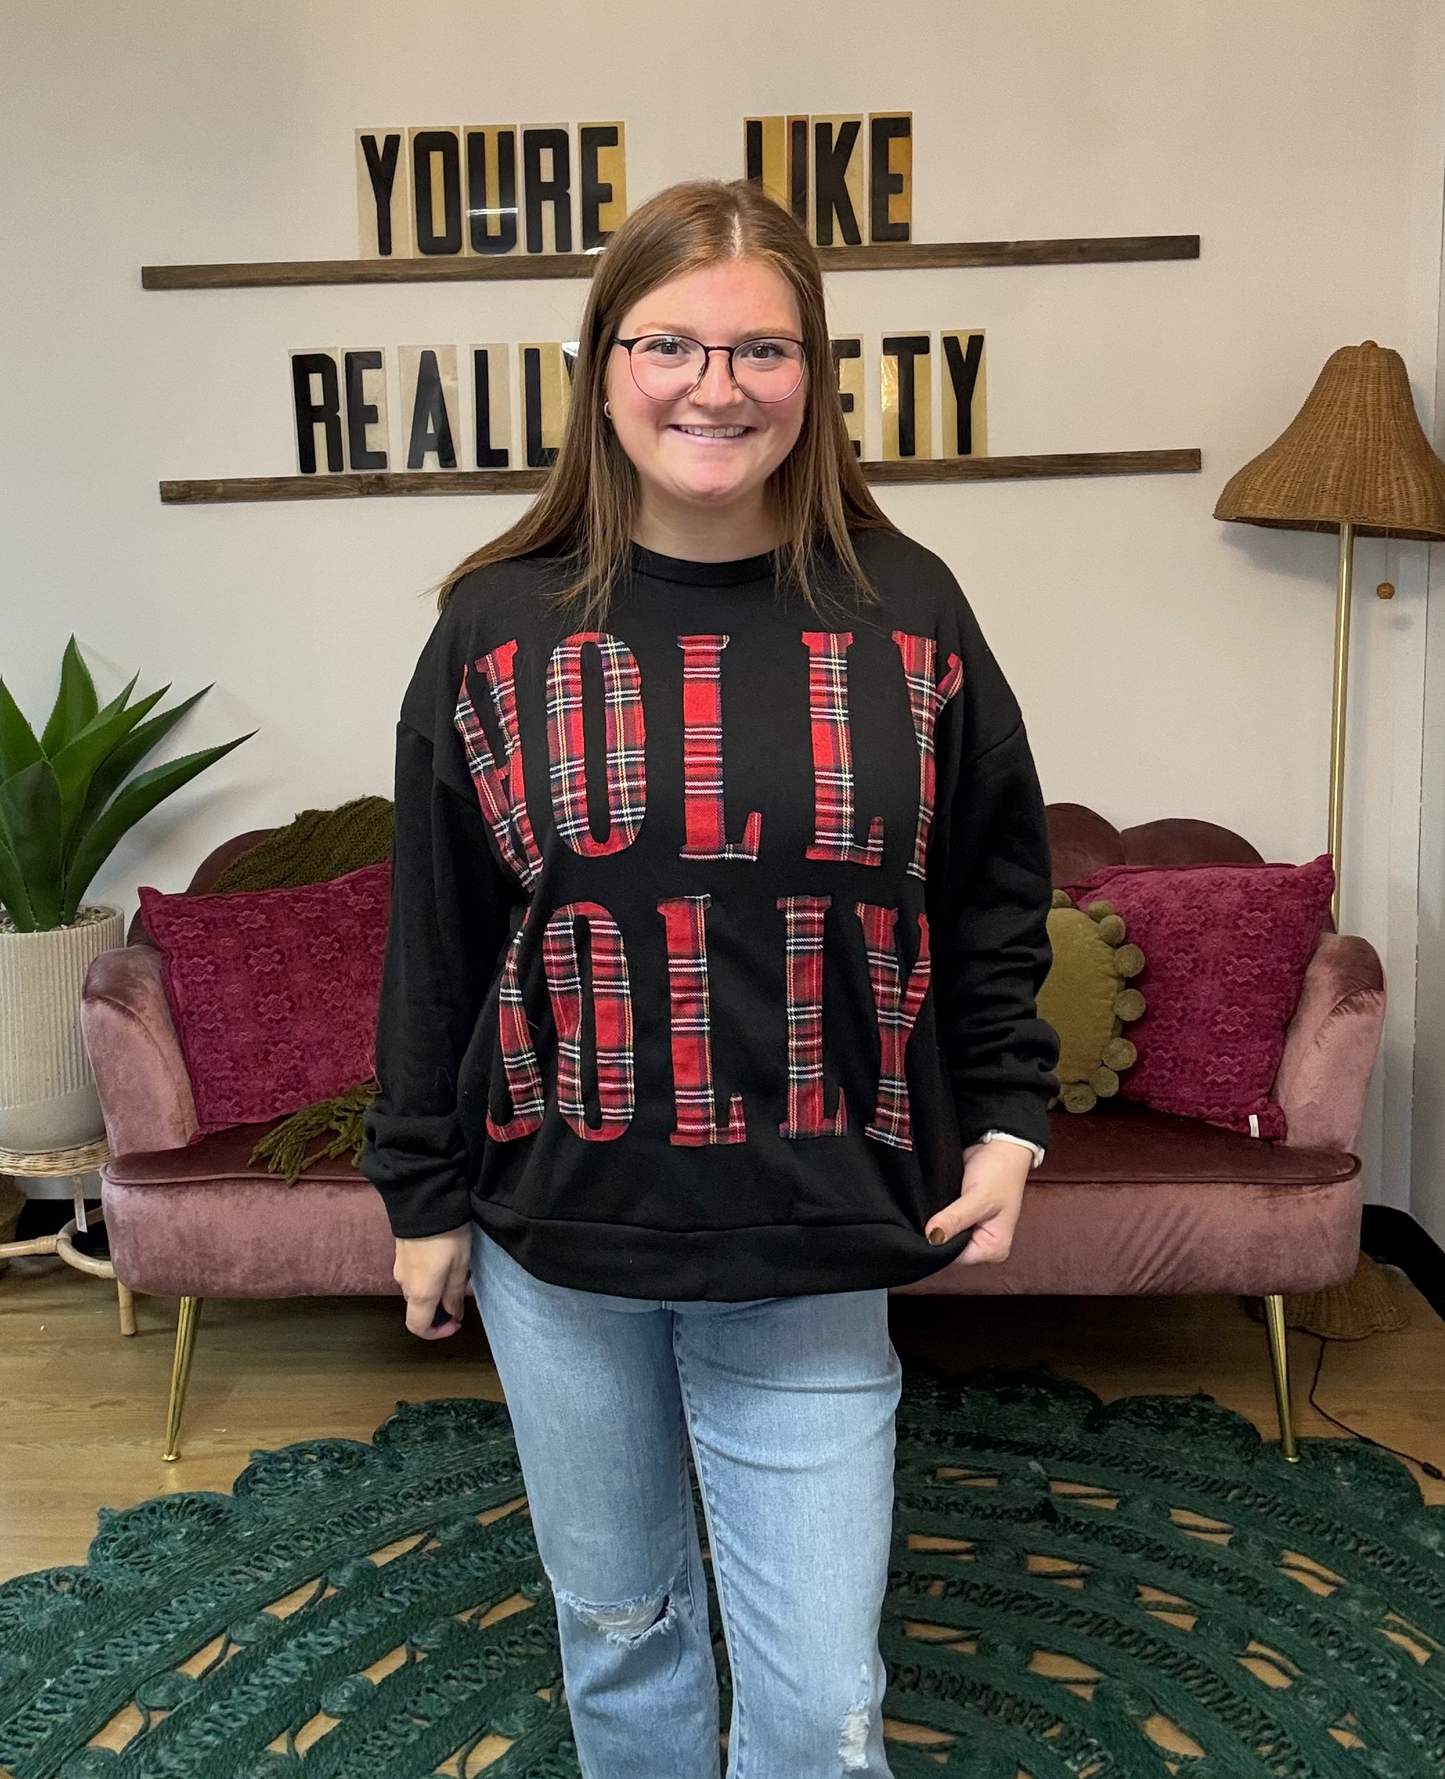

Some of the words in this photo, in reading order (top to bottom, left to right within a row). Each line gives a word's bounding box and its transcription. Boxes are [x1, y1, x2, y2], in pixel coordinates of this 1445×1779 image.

[360, 126, 619, 256] YOURE
[291, 348, 574, 474] REALL
[454, 631, 964, 894] HOLLY
[486, 893, 931, 1152] JOLLY
